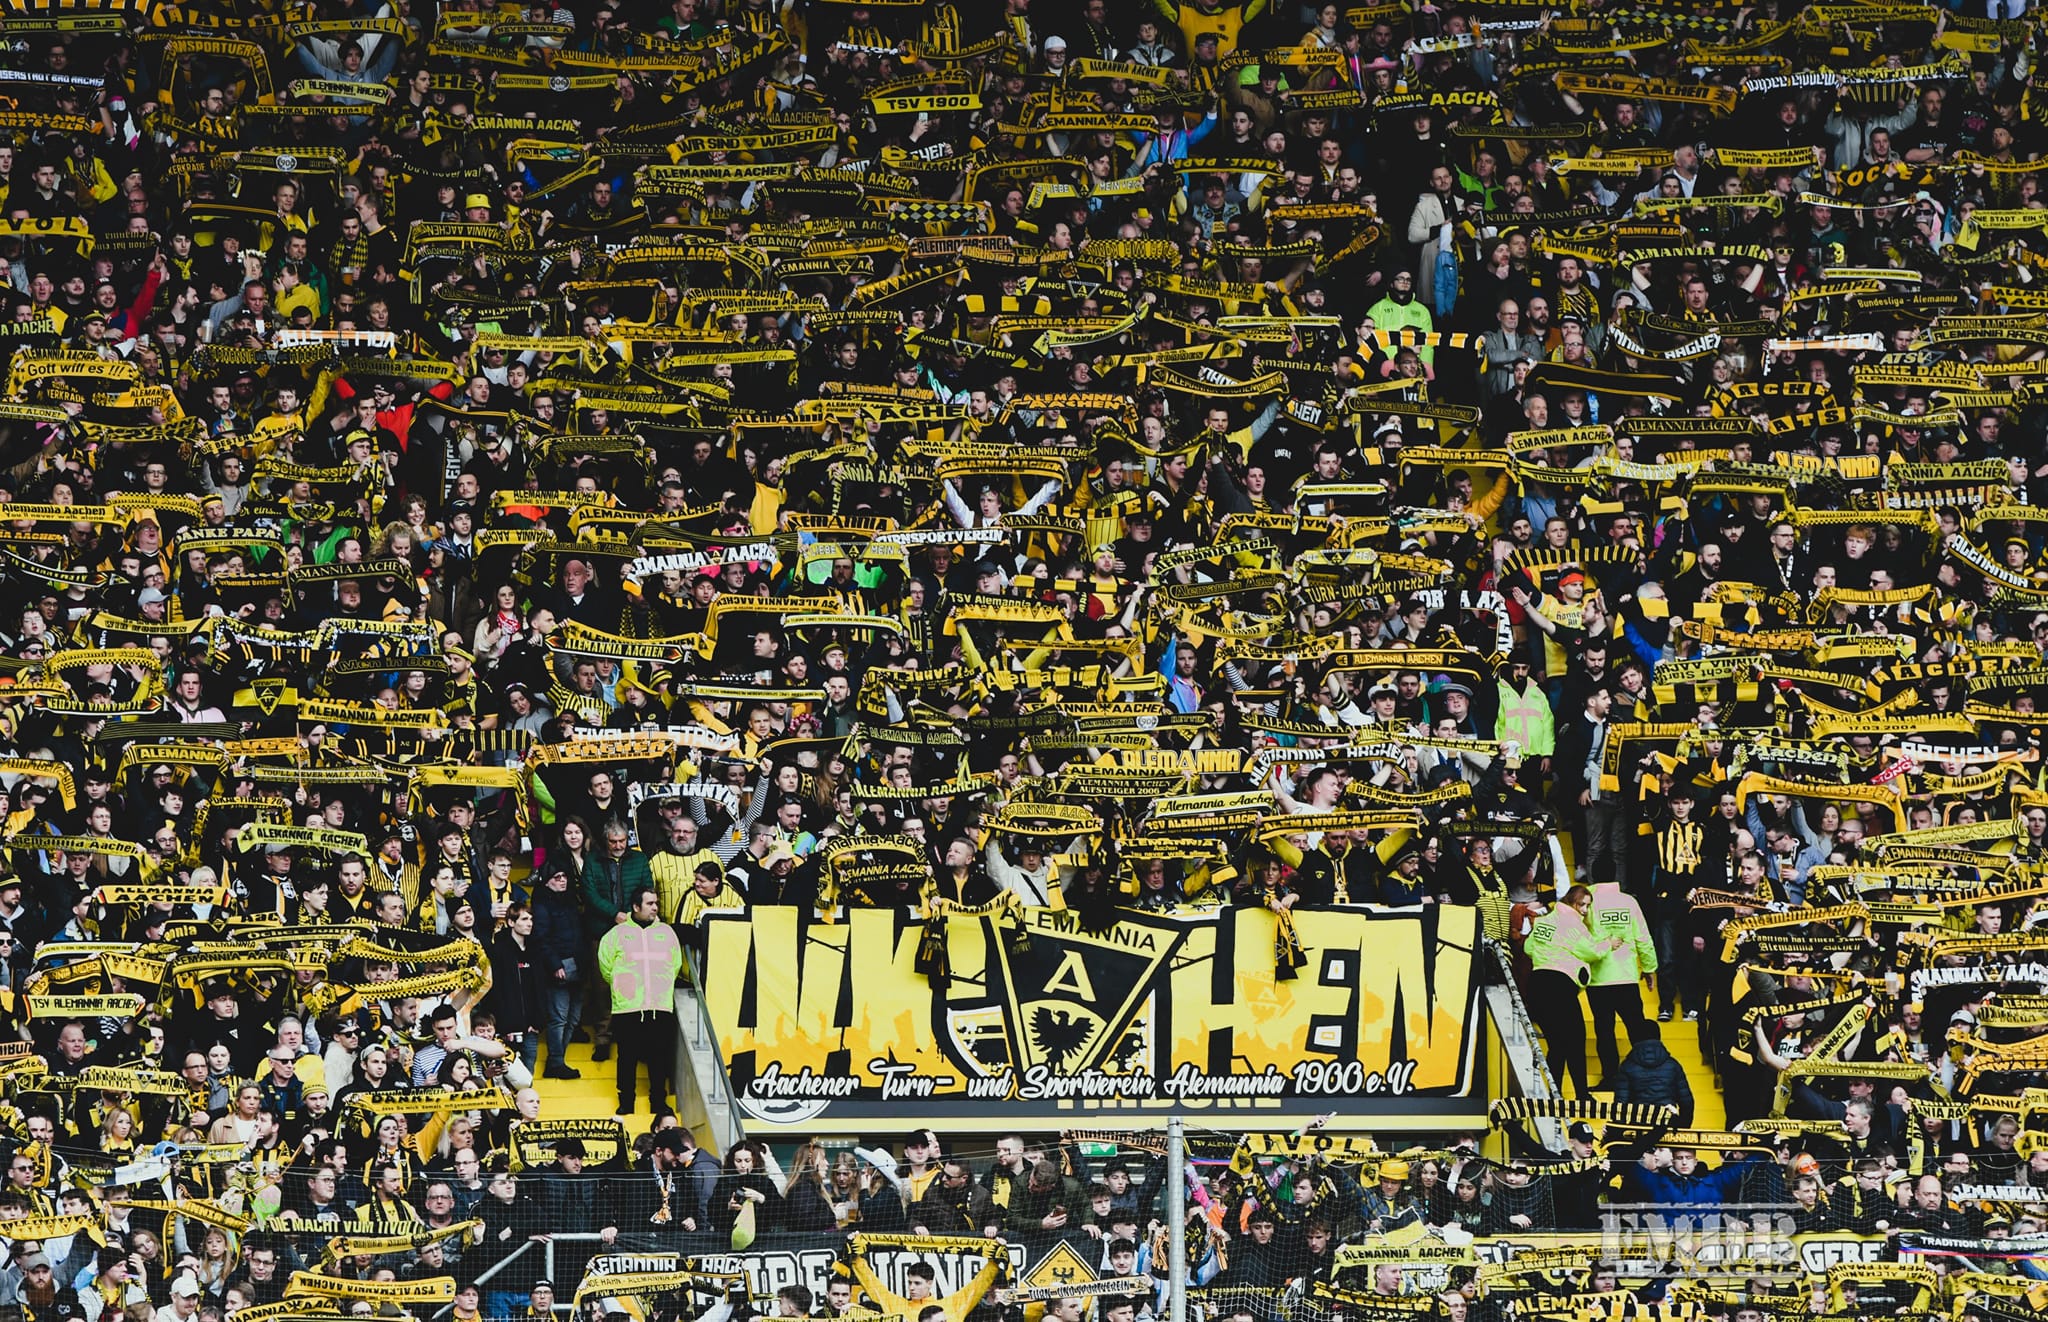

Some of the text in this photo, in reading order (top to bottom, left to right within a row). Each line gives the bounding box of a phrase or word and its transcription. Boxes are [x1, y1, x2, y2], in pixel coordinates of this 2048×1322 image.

[74, 20, 115, 29] RODA JC
[349, 18, 400, 31] WILLI
[694, 44, 765, 84] AACHEN
[1581, 56, 1626, 68] PAPA
[1090, 61, 1162, 78] ALEMANNIA AACHEN
[1301, 90, 1360, 101] ALEMANNIA
[1632, 84, 1708, 98] AACHEN
[704, 97, 744, 116] Aachen
[887, 95, 970, 110] TSV 1900
[1303, 97, 1361, 108] AACHEN
[679, 126, 837, 153] WIR SIND WIEDER DA
[1607, 160, 1627, 168] HAHN
[1732, 156, 1762, 165] IMMER
[655, 165, 787, 179] ALEMANNIA AACHEN
[802, 167, 912, 190] ALEMANNIA AACHEN
[1045, 181, 1118, 194] LIEBE MEIN
[2021, 214, 2035, 222] EIN
[1621, 246, 1714, 269] ALEMANNIA
[745, 289, 788, 299] Aachen
[1038, 281, 1127, 300] MINGE VEREIN
[1856, 293, 1959, 308] Bundesliga Alemannia
[846, 310, 899, 322] ALEMANNIA
[1933, 330, 2003, 342] ALEMANNIA
[920, 334, 1016, 362] MINGE VEREIN
[1879, 352, 1928, 365] ATSV
[27, 362, 54, 375] Gott
[84, 364, 105, 374] es
[405, 362, 450, 375] Aachen
[1856, 375, 1971, 388] ALEMANNIA AACHEN
[1022, 393, 1122, 402] ALEMANNIA
[1028, 400, 1120, 409] AACHEN
[28, 407, 63, 419] ALONE!
[1627, 416, 1744, 432] ALEMANNIA AACHEN
[216, 438, 249, 450] BESTEN
[1948, 466, 2007, 479] AACHEN
[514, 489, 599, 504] ALEMANNIA AACHEN
[1, 504, 106, 516] Alemannia Aachen
[577, 502, 723, 521] ALEMANNIA AACHEN
[232, 528, 276, 539] PAPA
[1339, 584, 1364, 599] UND
[1365, 575, 1436, 595] SPORTVEREIN
[949, 593, 972, 604] TSV
[564, 639, 664, 658] ALEMANNIA AACHEN
[1353, 653, 1443, 665] ALEMANNIA AACHEN
[308, 706, 429, 723] ALEMANNIA AACHEN
[1260, 716, 1333, 735] ALEMANNIA
[1848, 723, 1918, 732] 17.03.2004
[1103, 735, 1147, 746] Aachen
[139, 747, 223, 761] ALEMANNIA
[1747, 744, 1838, 762] Aachen
[1122, 749, 1240, 772] ALEMANNIA
[326, 770, 350, 778] WALK
[1071, 766, 1165, 777] ALEMANNIA
[856, 779, 982, 798] ALEMANNIA AACHEN
[1075, 778, 1171, 787] ALEMANNIA AACHEN
[1079, 786, 1160, 795] AUFSTEIGER 2006
[1434, 785, 1458, 798] 2004
[1160, 799, 1225, 814] Alemannia
[1168, 818, 1223, 830] ALEMANNIA
[256, 828, 365, 846] ALEMANNIA AACHEN
[89, 838, 138, 855] Aachen
[1883, 847, 1978, 863] ALEMANNIA AACHEN
[114, 894, 214, 903] AACHEN
[1600, 910, 1630, 924] SBG
[1001, 907, 1157, 952] ALEMANNIA
[1532, 925, 1556, 940] SBG
[1758, 942, 1814, 952] Alemannia
[1042, 949, 1097, 1002] A
[31, 996, 103, 1010] TSV ALEMANNIA
[753, 1058, 1414, 1101] Aachener Turn- und Sportverein Alemannia 1900 e.V.
[450, 1088, 494, 1100] PAPA
[520, 1120, 619, 1132] ALEMANNIA
[1700, 1133, 1741, 1145] AACHEN
[268, 1216, 290, 1232] DIE
[292, 1216, 339, 1232] MACHT
[858, 1234, 995, 1248] ALEMANNIA AACHEN
[1921, 1237, 1978, 1248] TRADITION
[1344, 1247, 1465, 1259] ALEMANNIA AACHEN
